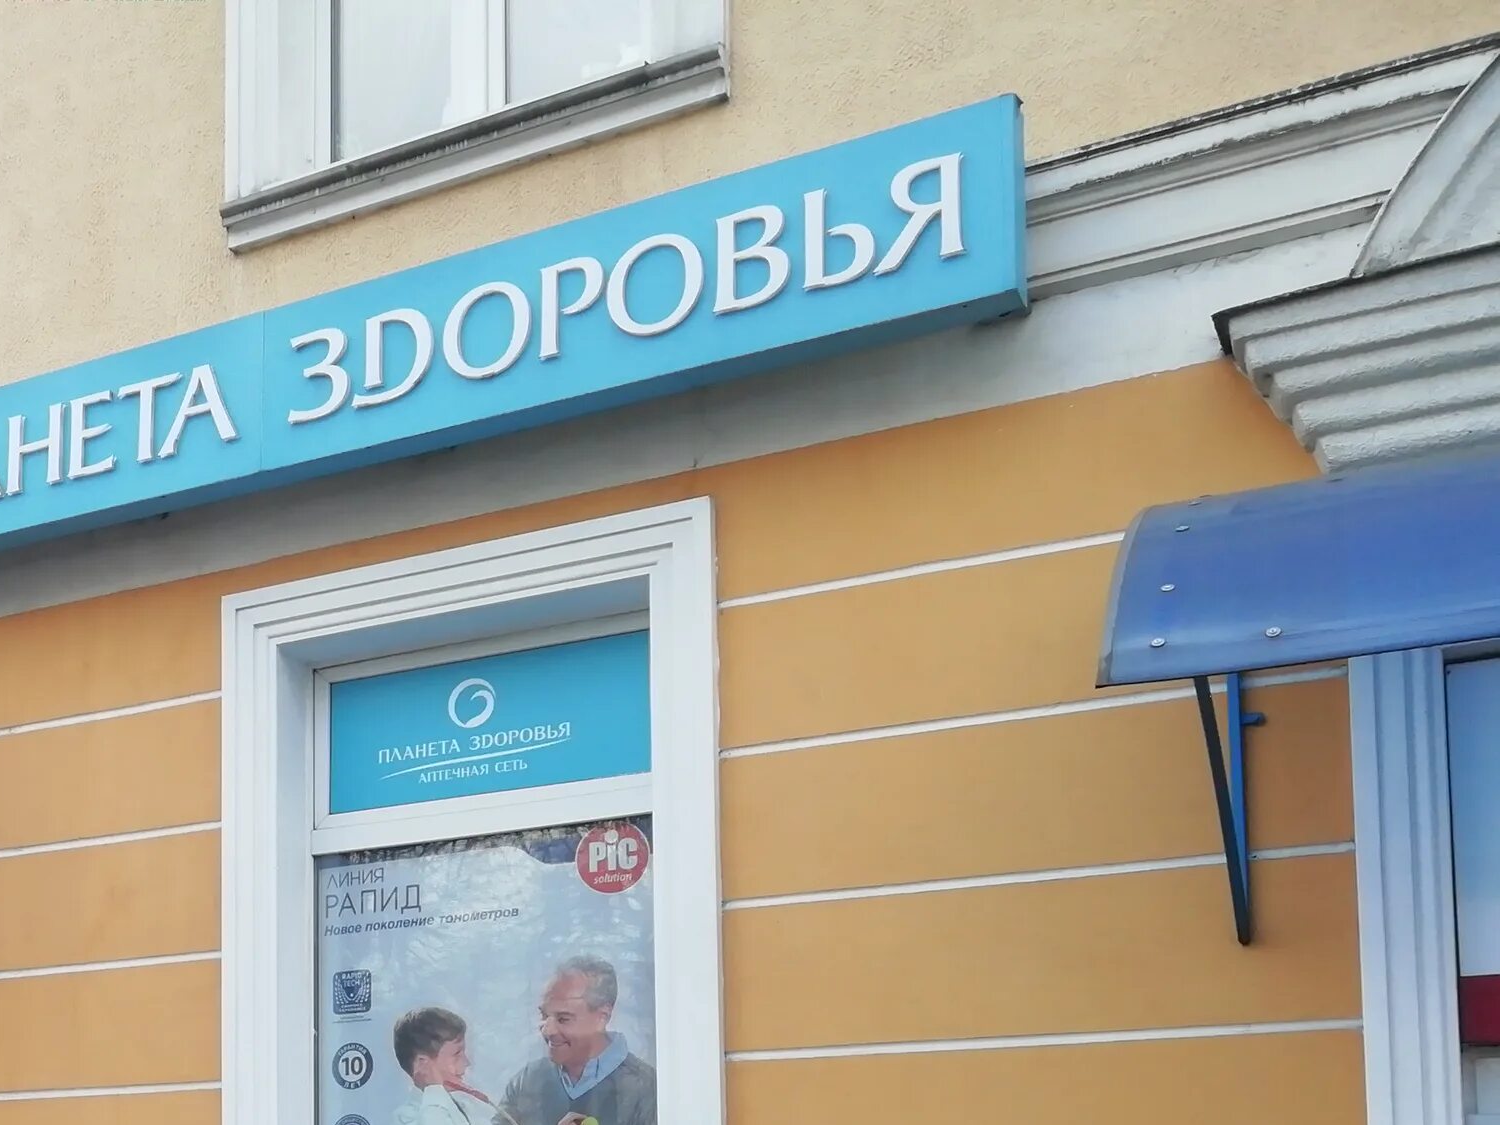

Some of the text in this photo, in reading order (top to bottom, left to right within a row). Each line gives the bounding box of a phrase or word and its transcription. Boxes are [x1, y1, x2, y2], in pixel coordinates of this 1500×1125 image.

[287, 151, 968, 426] ЗДОРОВЬЯ
[378, 721, 572, 765] ПЛАНЕТА ЗДОРОВЬЯ
[418, 758, 528, 785] АПТЕЧНАЯ СЕТЬ
[327, 867, 384, 889] ЛИНИЯ
[593, 872, 633, 885] solution
[325, 884, 422, 919] РАПИД
[324, 905, 520, 937] Новое поколение тонометров
[341, 1056, 363, 1076] 10
